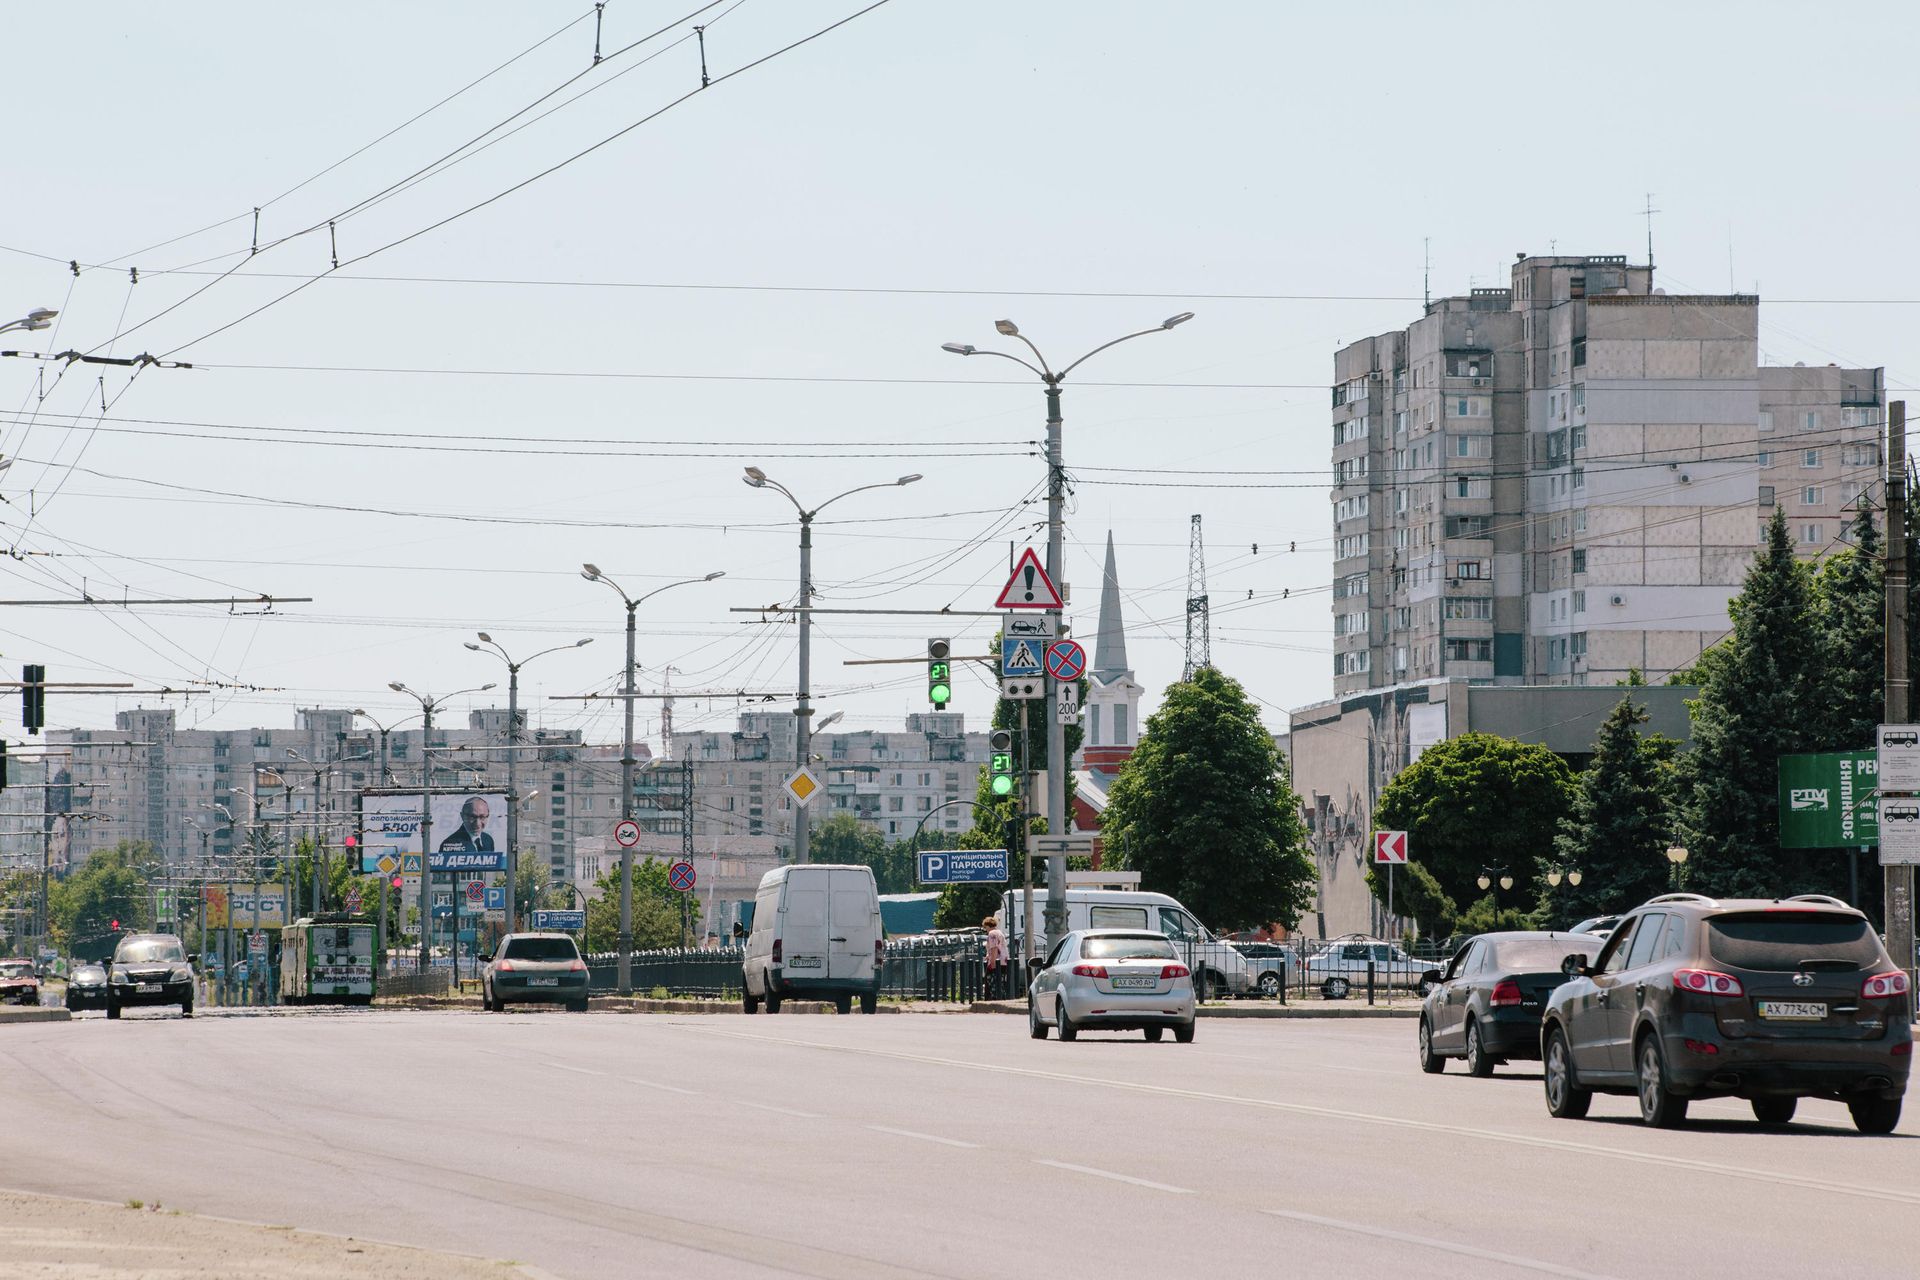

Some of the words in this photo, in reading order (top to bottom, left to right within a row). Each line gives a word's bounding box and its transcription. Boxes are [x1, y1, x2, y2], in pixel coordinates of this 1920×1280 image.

[932, 665, 948, 679] 27
[1058, 702, 1076, 715] 200
[993, 756, 1010, 769] 27
[1857, 760, 1878, 775] РЕК
[1840, 760, 1854, 840] ЗОВНІШНЯ
[383, 822, 419, 832] БЛОК
[446, 855, 498, 867] ДЕЛАМ!
[951, 860, 1004, 869] ПАРКОВКА
[1766, 1003, 1782, 1015] AX
[1783, 1003, 1809, 1016] 7734
[1809, 1004, 1826, 1016] CM
